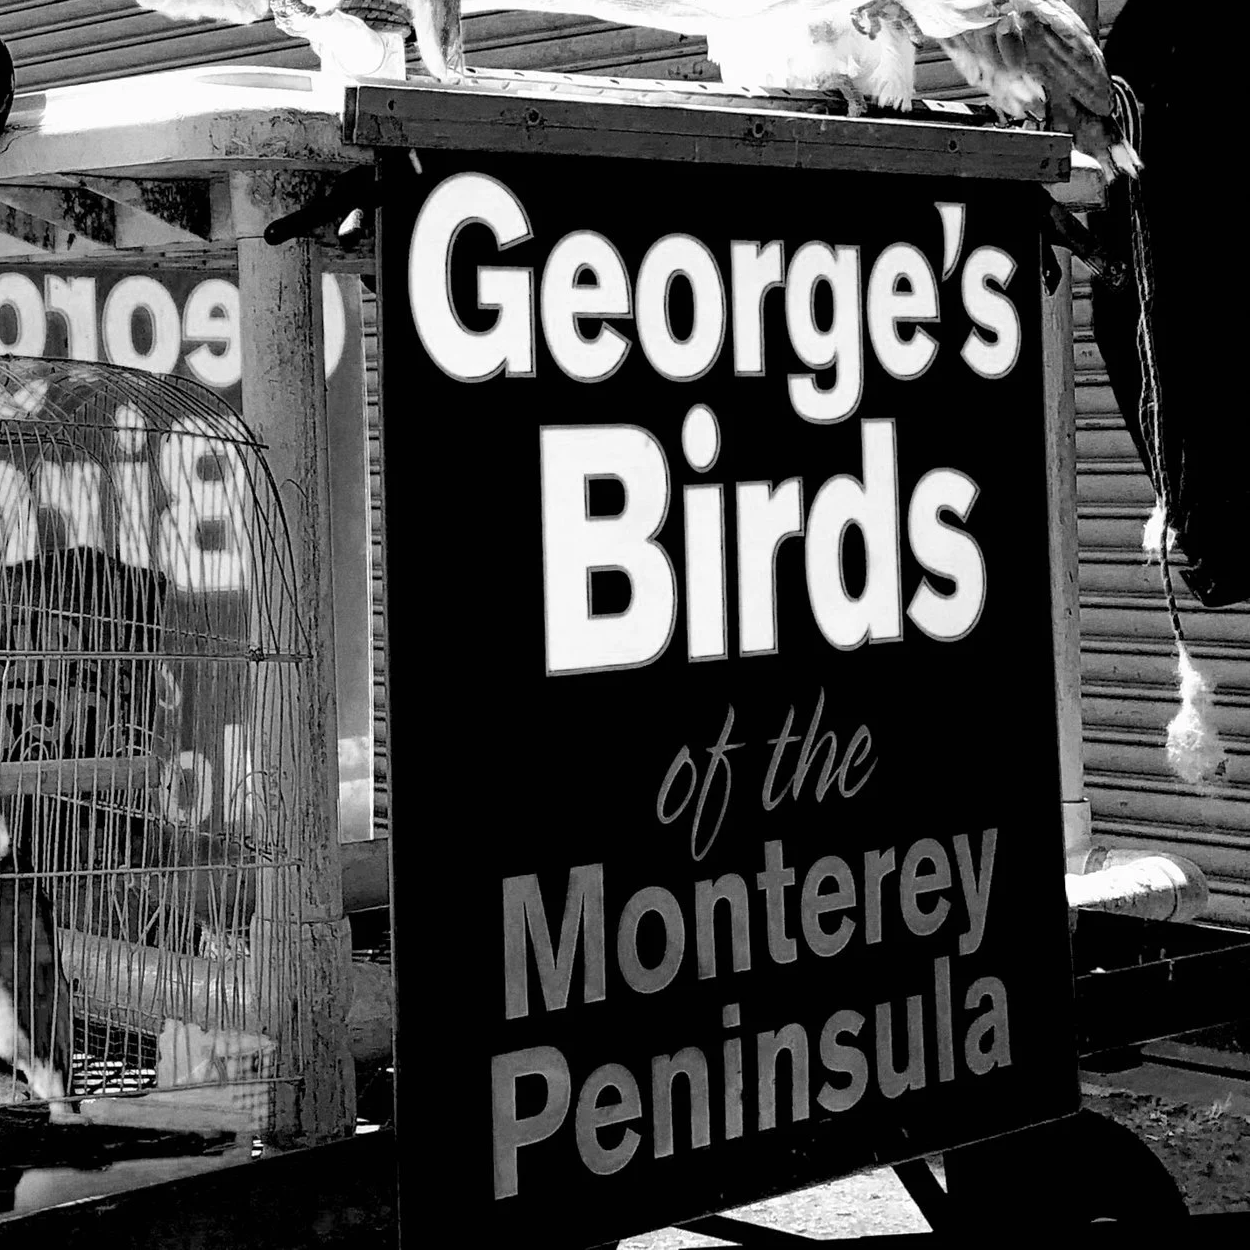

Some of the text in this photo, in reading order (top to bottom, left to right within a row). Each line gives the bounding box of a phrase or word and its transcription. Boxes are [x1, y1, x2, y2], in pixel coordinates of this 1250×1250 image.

[408, 171, 1021, 424] George's
[539, 403, 987, 677] Birds
[656, 686, 878, 861] of the
[502, 827, 999, 1020] Monterey
[491, 956, 1012, 1201] Peninsula
